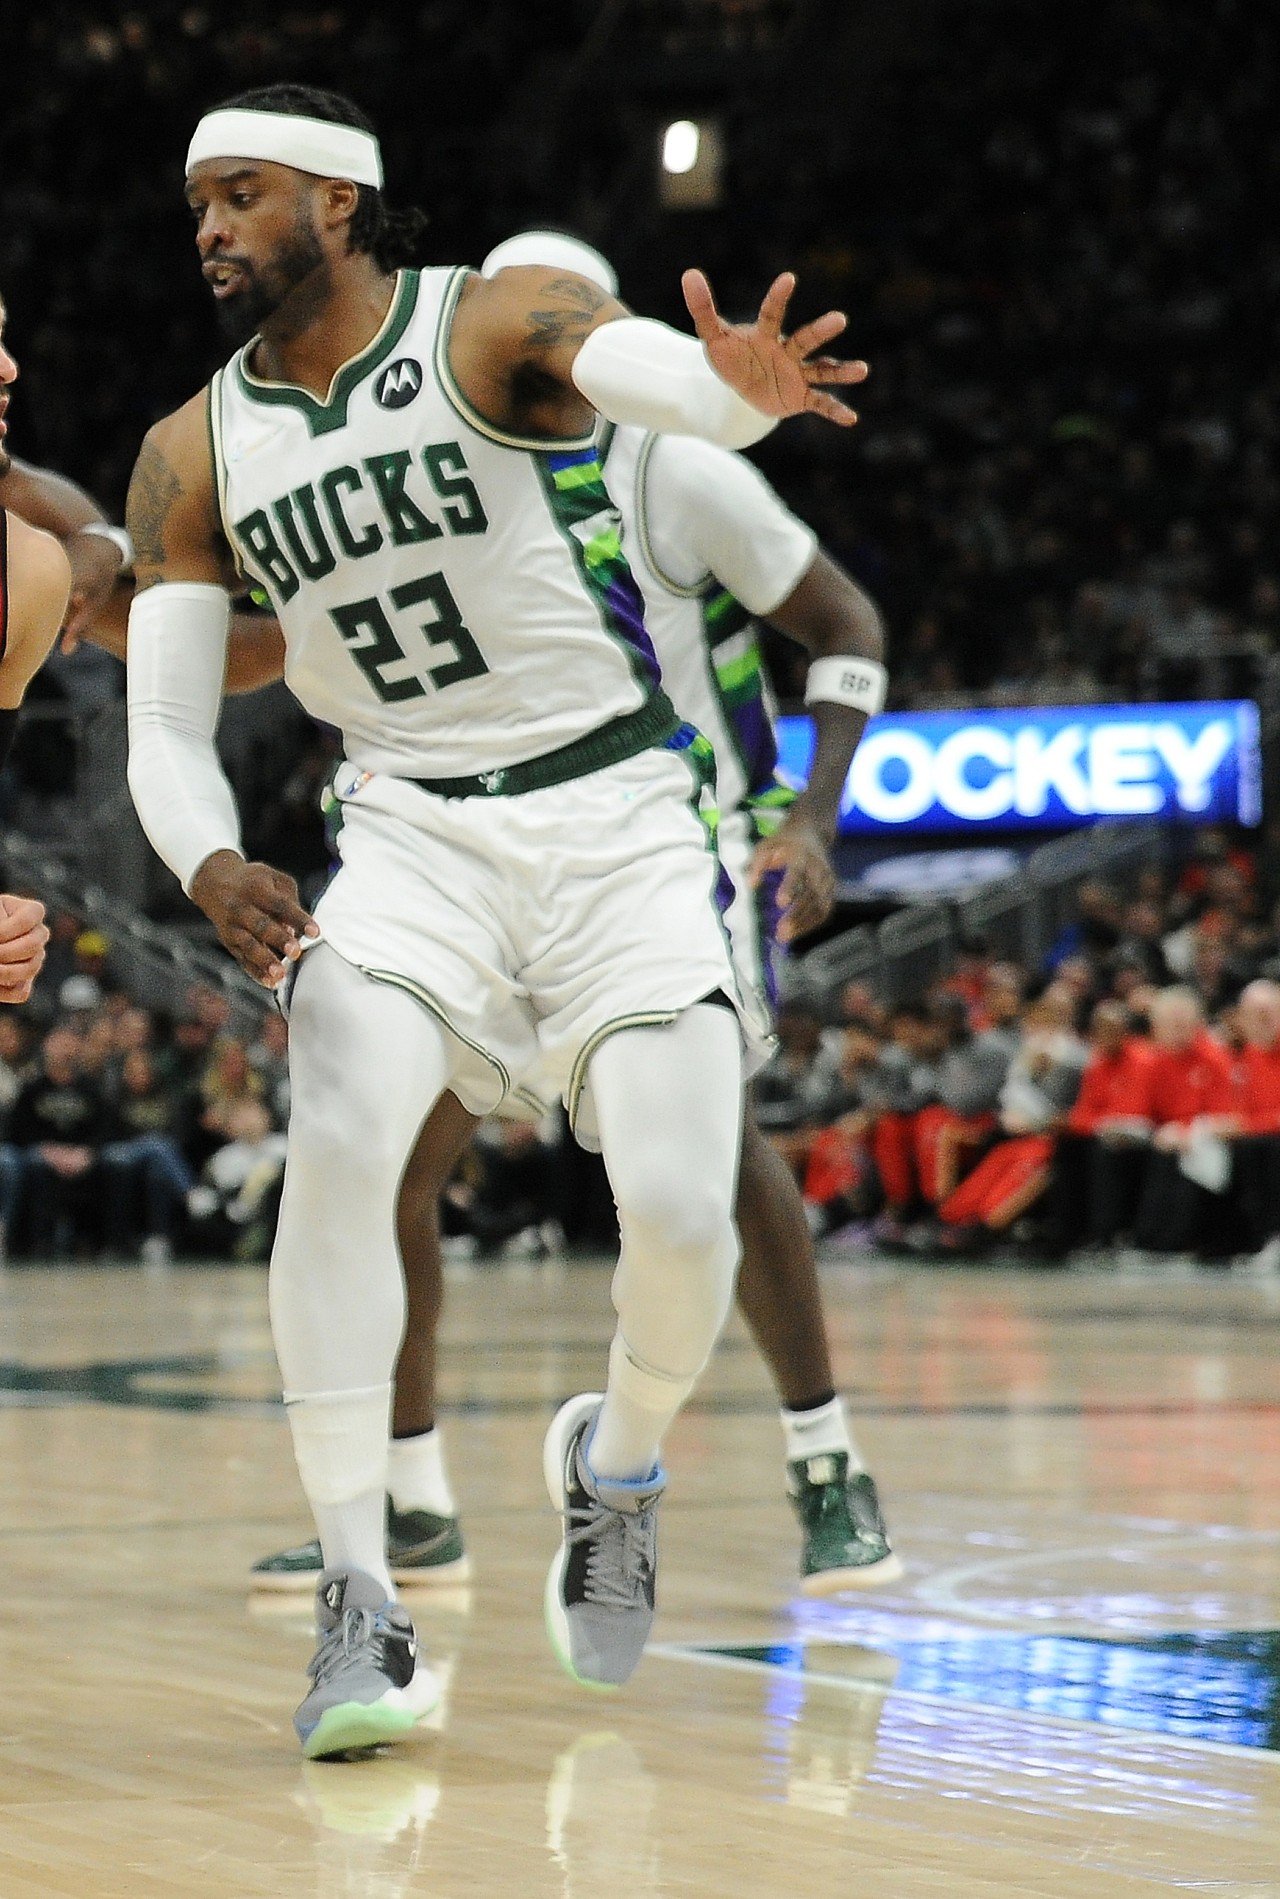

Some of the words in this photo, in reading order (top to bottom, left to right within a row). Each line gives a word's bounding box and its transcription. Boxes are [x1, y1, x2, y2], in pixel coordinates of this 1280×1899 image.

[232, 440, 489, 606] BUCKS
[327, 570, 491, 705] 23
[841, 716, 1237, 824] OCKEY
